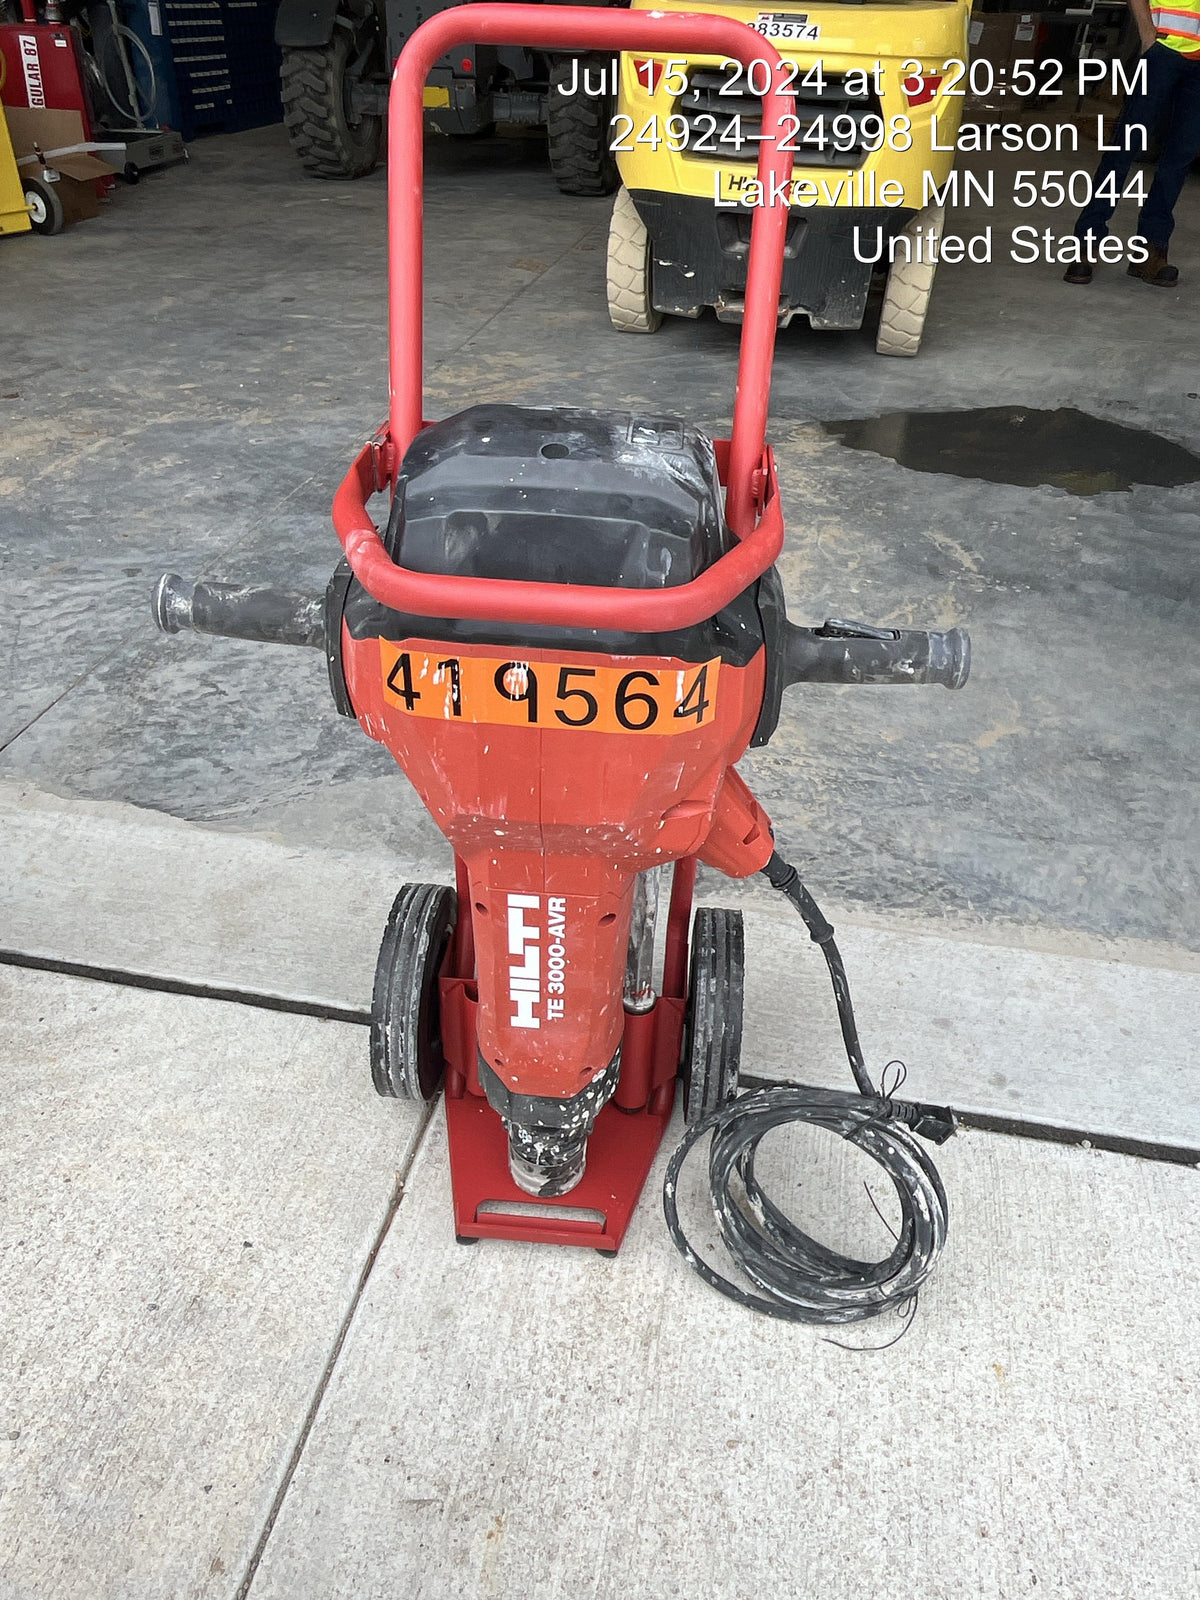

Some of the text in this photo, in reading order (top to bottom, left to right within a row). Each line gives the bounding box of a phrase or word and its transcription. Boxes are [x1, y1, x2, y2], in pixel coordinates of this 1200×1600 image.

[23, 40, 37, 56] 87
[507, 893, 540, 1029] HILTI
[546, 896, 566, 1021] TE 3000-AVR
